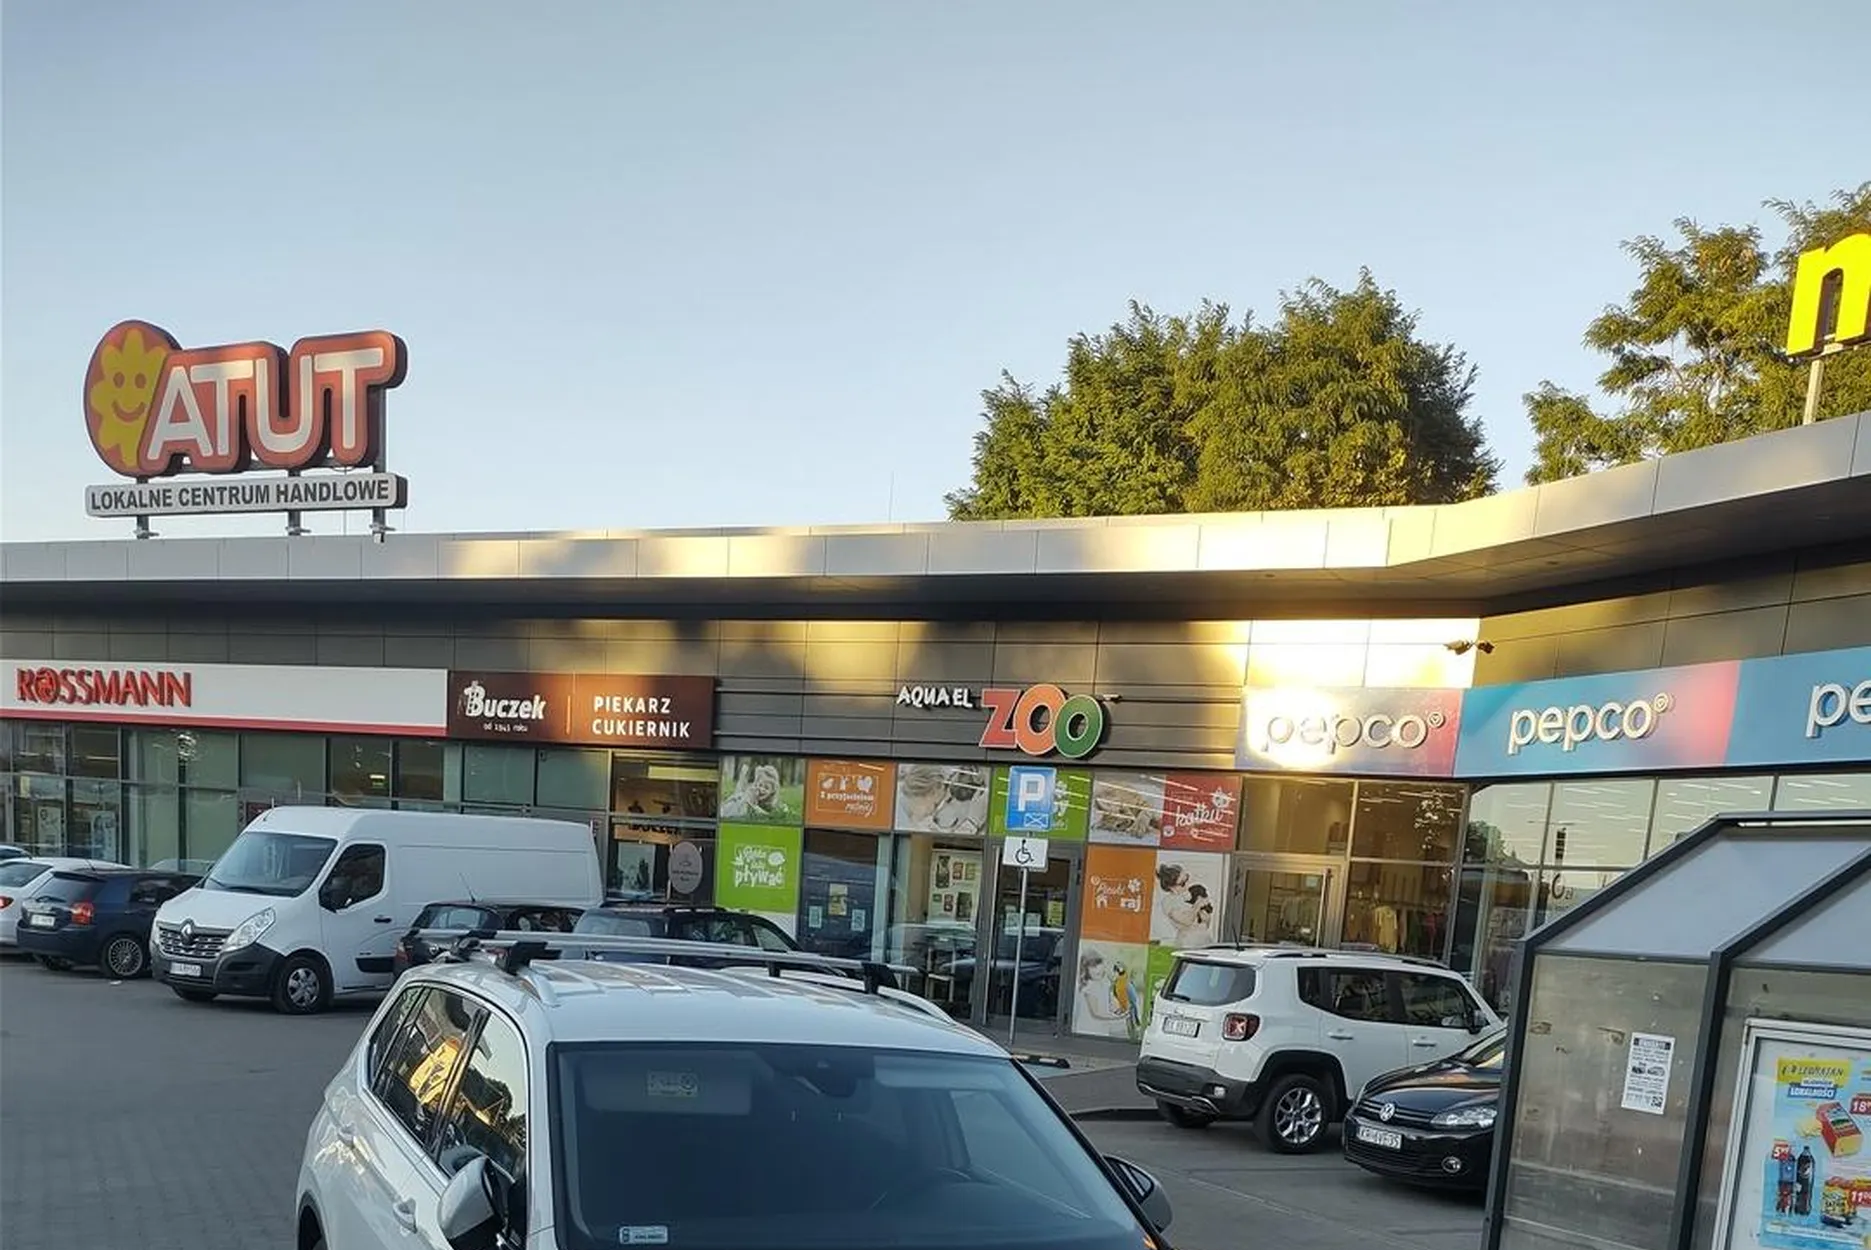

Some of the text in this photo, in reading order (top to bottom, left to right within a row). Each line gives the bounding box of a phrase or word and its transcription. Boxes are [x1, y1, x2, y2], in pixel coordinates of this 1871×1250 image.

[147, 346, 384, 460] ATUT
[90, 479, 390, 511] LOKALNE CENTRUM HANDLOWE
[16, 667, 192, 708] ROSSMANN
[463, 680, 547, 720] Buczek
[593, 695, 671, 715] PIEKARZ
[591, 718, 691, 739] CUKIERNIK
[979, 683, 1104, 758] ZOO
[1261, 714, 1429, 755] pepco
[1508, 701, 1653, 755] pepco
[1017, 772, 1047, 813] P
